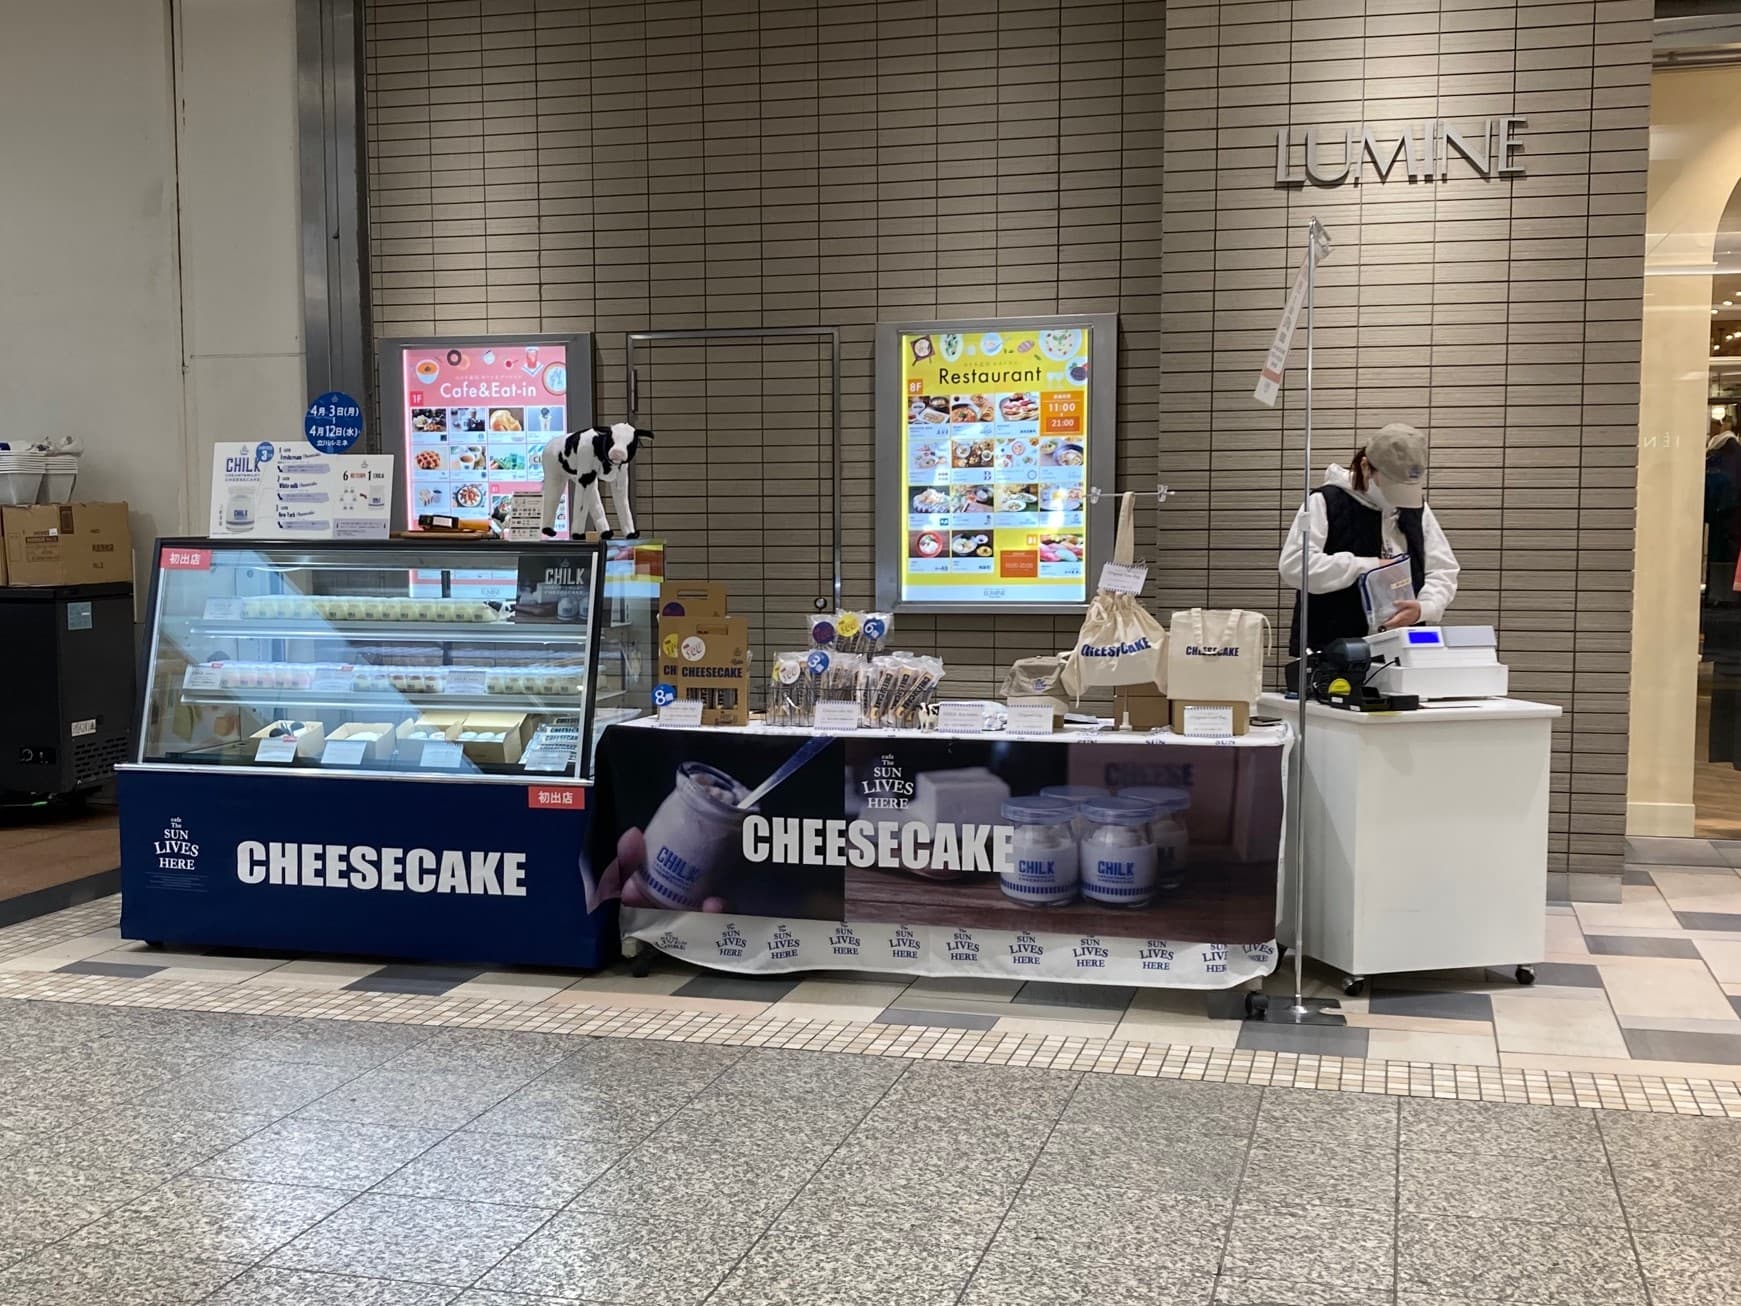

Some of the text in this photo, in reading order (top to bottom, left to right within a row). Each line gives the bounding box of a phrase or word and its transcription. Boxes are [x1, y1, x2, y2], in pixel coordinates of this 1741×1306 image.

[1276, 118, 1527, 184] LUMINE
[939, 367, 1042, 385] Restaurant
[440, 382, 537, 398] Cafe&Eat-in
[1049, 402, 1076, 412] 11:00
[309, 425, 359, 437] 4月12日(水)
[226, 457, 261, 473] CHILK
[169, 552, 201, 566] 初出店
[545, 568, 585, 585] CHILK
[682, 667, 743, 678] CHEESECAKE
[873, 767, 902, 778] SUN
[861, 779, 914, 795] LIVES
[538, 790, 574, 805] 初出店
[867, 797, 909, 809] HERE
[164, 829, 189, 840] SUN
[154, 841, 199, 857] LIVES
[742, 815, 1015, 873] CHEESECAKE
[159, 858, 195, 870] HERE
[237, 841, 527, 897] CHEESECAKE
[1018, 860, 1055, 875] CHILK
[1097, 861, 1134, 876] CHILK
[722, 930, 741, 938] SUN
[836, 928, 853, 936] SUN
[896, 930, 914, 938] SUN
[715, 938, 748, 949] LIVES
[768, 939, 800, 951] LIVES
[829, 935, 861, 947] LIVES
[889, 938, 921, 950] LIVES
[946, 941, 980, 952] LIVES
[1147, 940, 1167, 948] SUN
[720, 949, 743, 957] HERE
[771, 949, 798, 960] HERE
[833, 947, 859, 956] HERE
[892, 950, 918, 959] HERE
[1009, 944, 1044, 956] LIVES
[1072, 947, 1109, 958] LIVES
[1140, 949, 1175, 960] LIVES
[951, 953, 978, 961] HERE
[1013, 956, 1041, 965] HERE
[1077, 959, 1105, 968] HERE
[1142, 961, 1170, 971] HERE
